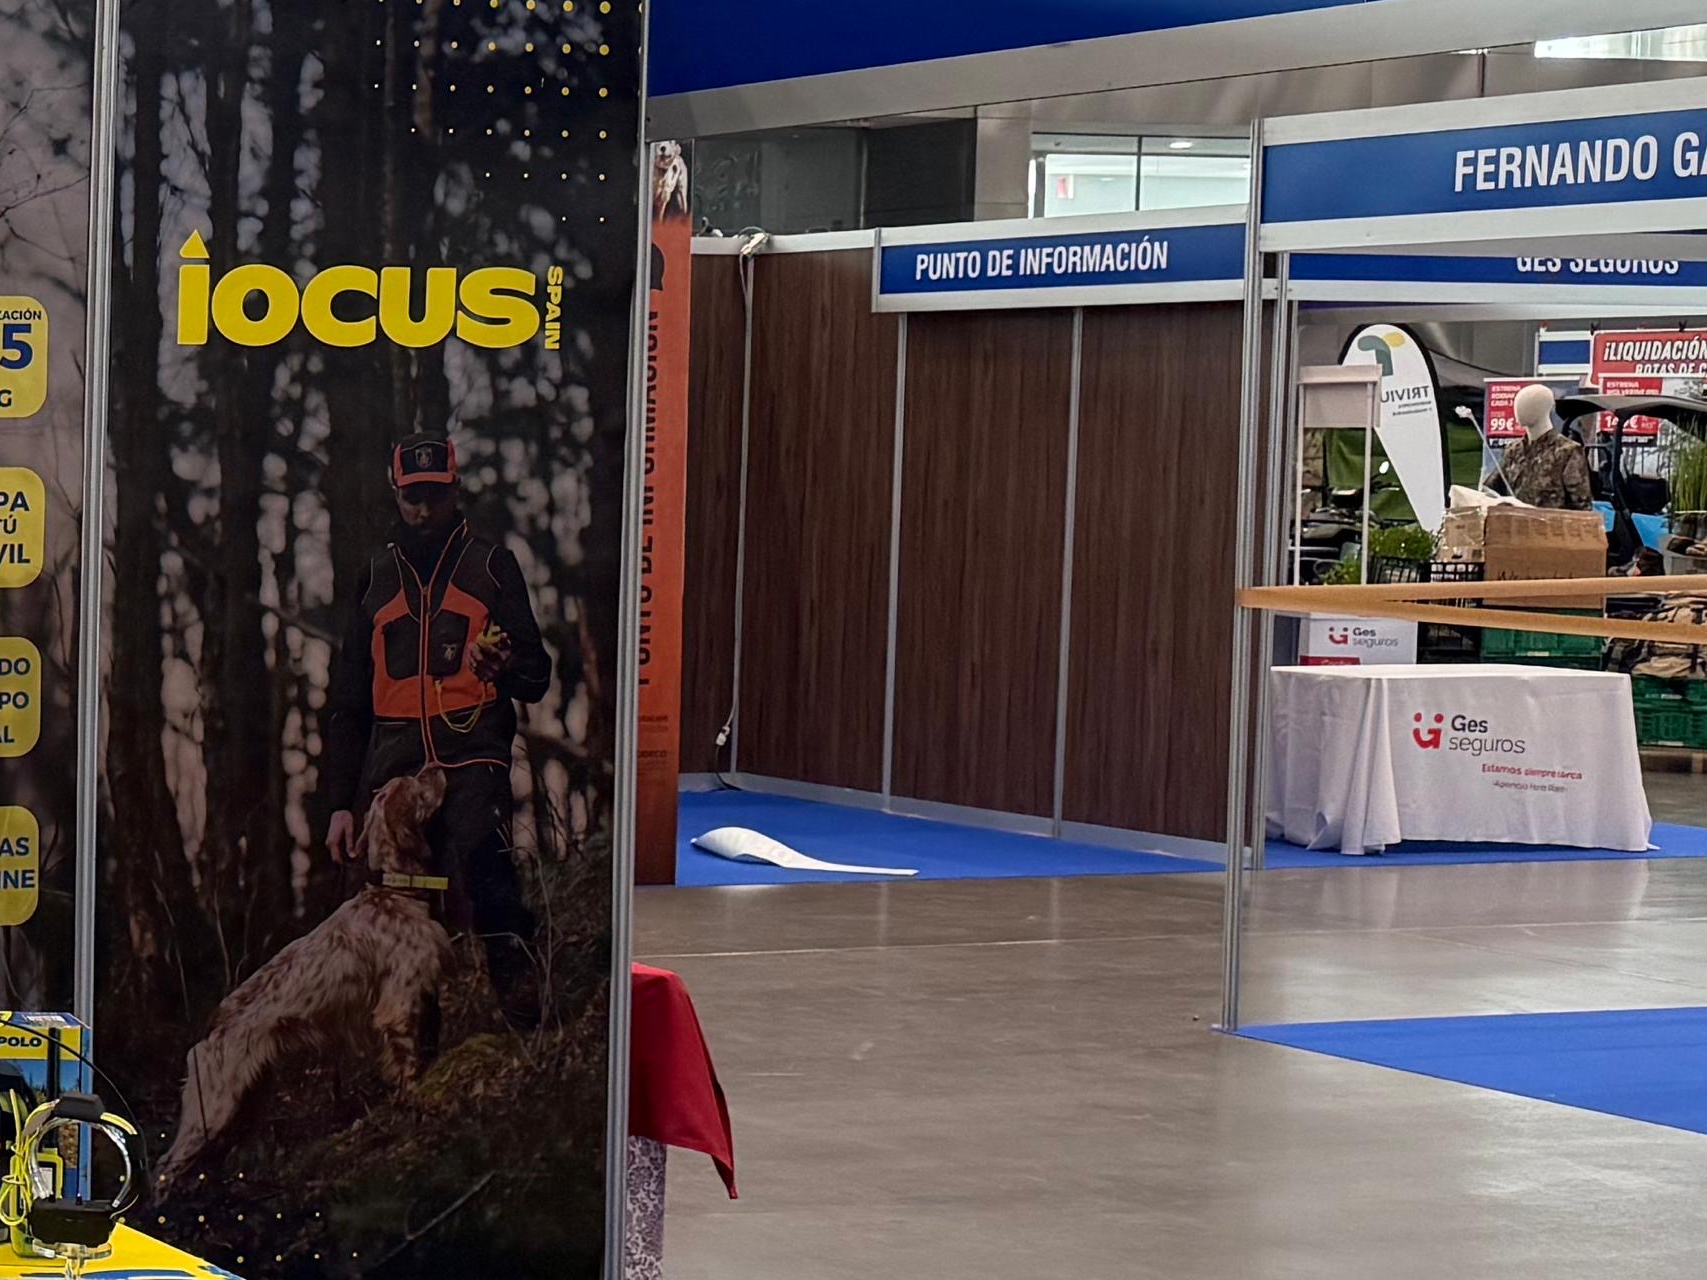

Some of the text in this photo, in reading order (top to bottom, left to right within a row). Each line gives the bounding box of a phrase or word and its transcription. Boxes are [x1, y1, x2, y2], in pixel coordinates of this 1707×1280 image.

[1454, 135, 1659, 193] FERNANDO
[914, 235, 1169, 282] PUNTO DE INFORMACIÓN
[543, 264, 564, 350] SPAIN
[1353, 627, 1376, 636] Ges
[1353, 637, 1398, 648] seguros
[1452, 715, 1488, 733] Ges
[1448, 735, 1526, 756] seguros
